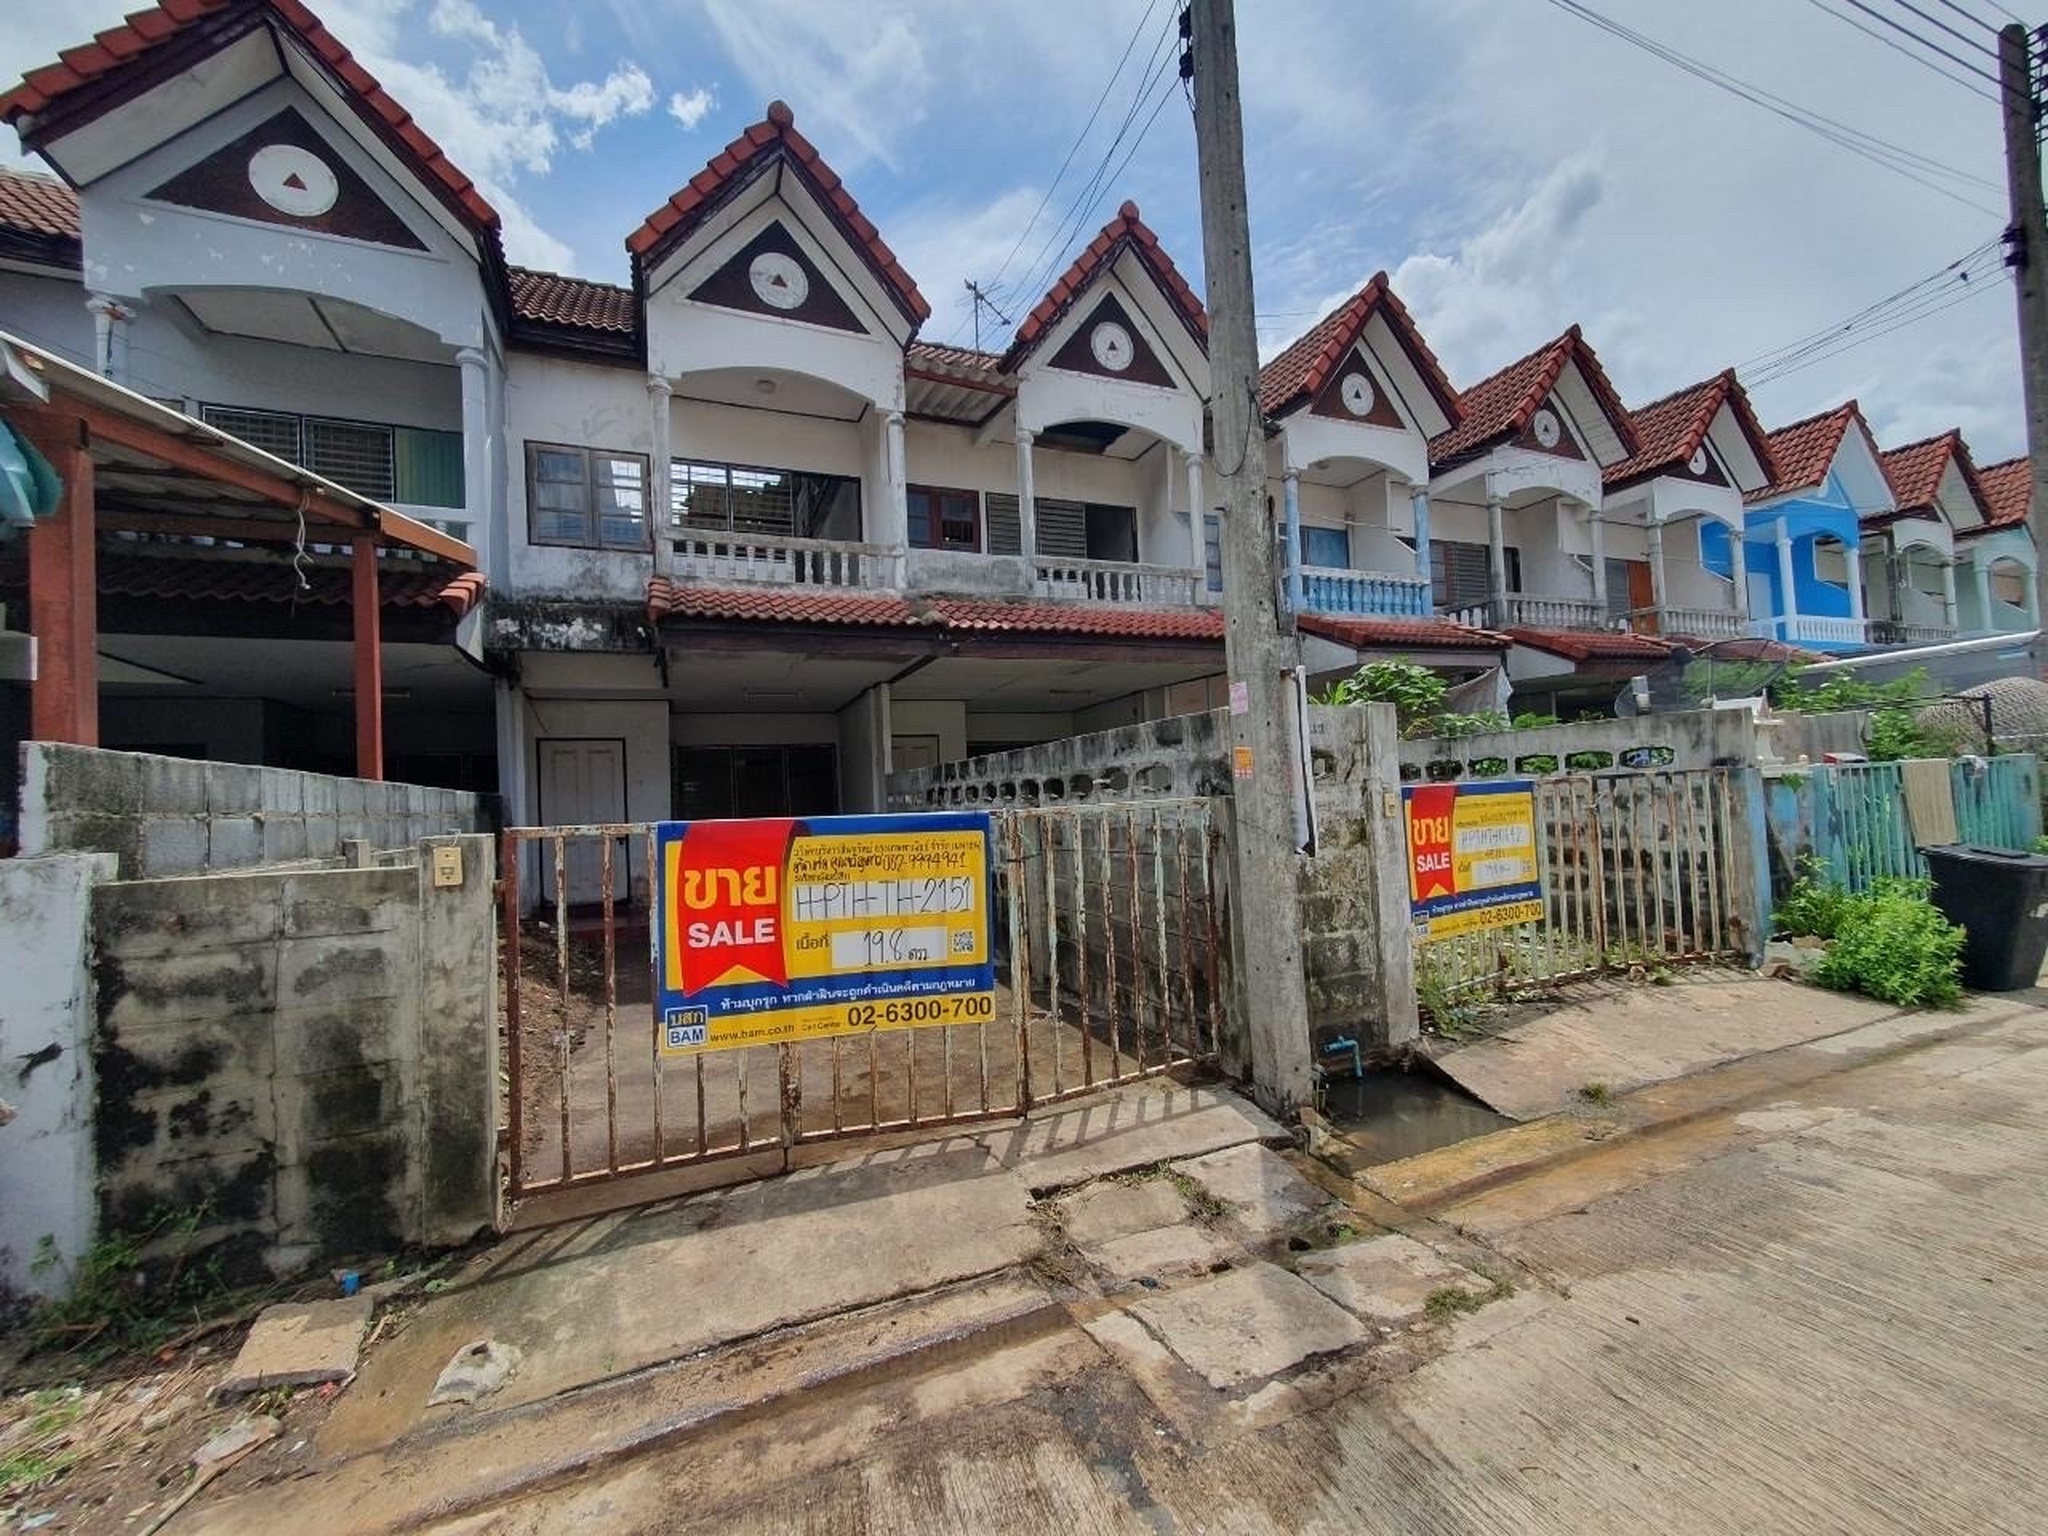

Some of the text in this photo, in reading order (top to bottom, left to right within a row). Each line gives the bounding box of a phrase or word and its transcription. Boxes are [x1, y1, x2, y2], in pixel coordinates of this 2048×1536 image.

[1412, 816, 1449, 845] ขาย
[1416, 852, 1450, 872] SALE
[684, 866, 777, 910] ขาย
[688, 917, 776, 949] SALE
[796, 932, 830, 951] เนื้อที่
[847, 996, 992, 1027] 02-6300-700
[670, 1028, 704, 1044] BAM
[709, 1024, 795, 1043] www.bam.co.th
